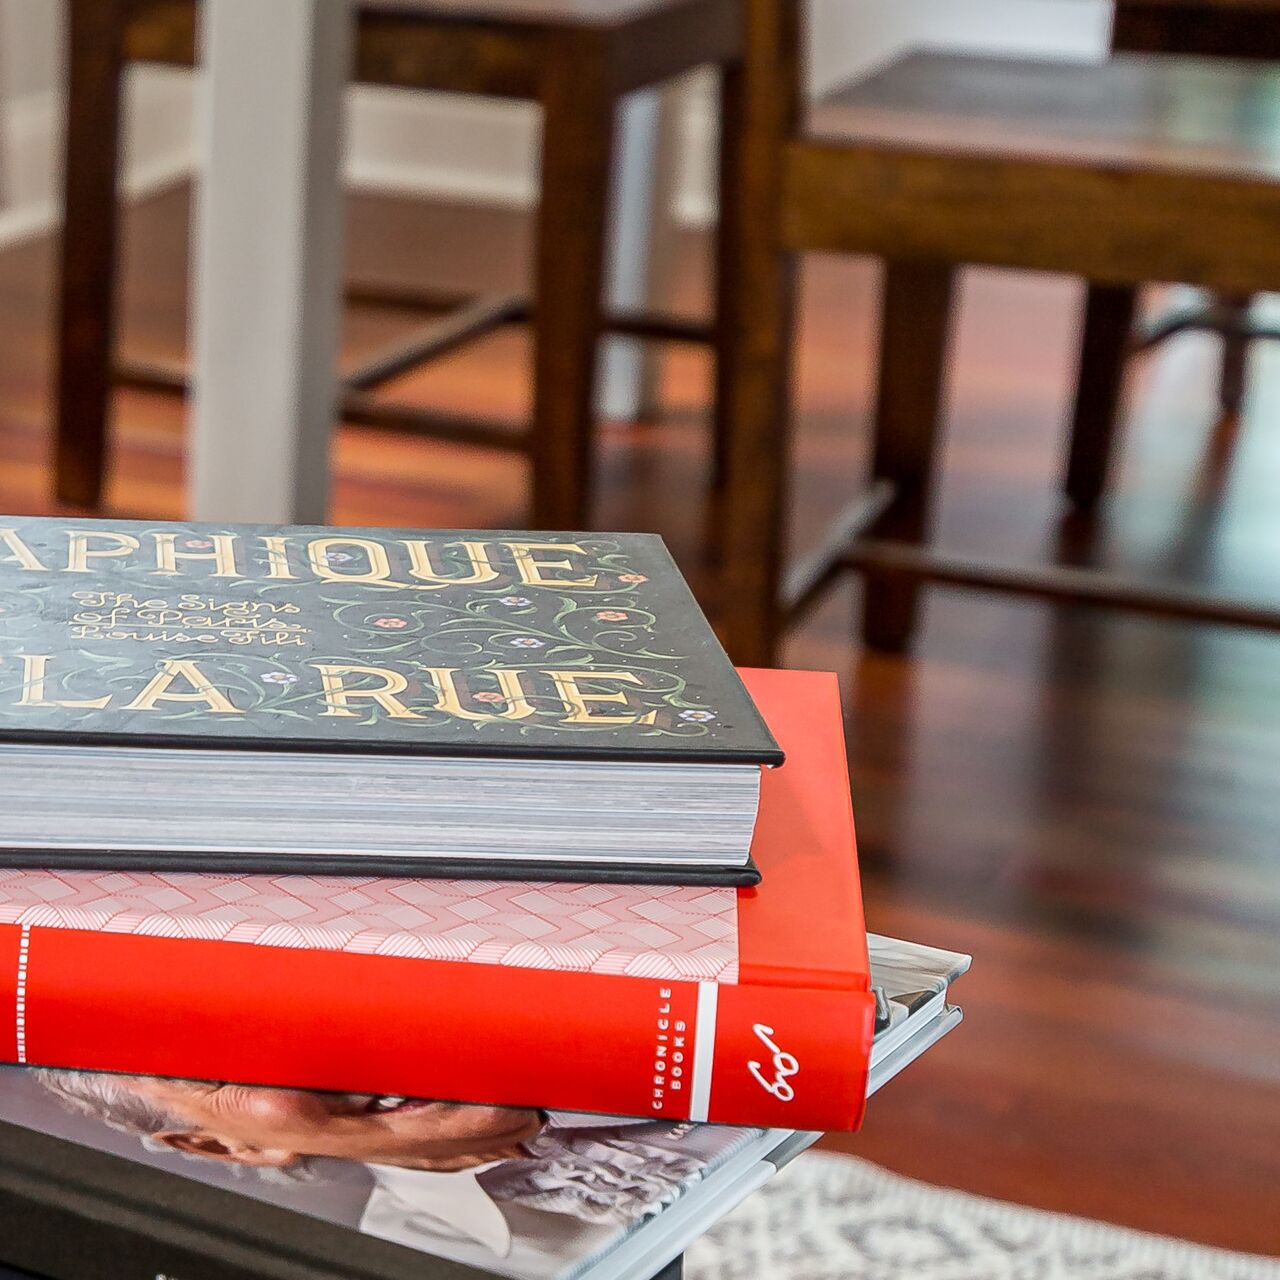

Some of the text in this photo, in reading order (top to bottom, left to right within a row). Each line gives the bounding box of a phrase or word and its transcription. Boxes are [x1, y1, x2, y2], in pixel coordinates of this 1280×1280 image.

[70, 626, 307, 646] Louise Fili
[71, 591, 301, 618] The Signs
[12, 653, 248, 715] LA
[311, 664, 657, 725] RUE
[651, 986, 672, 1111] CHRONICLE
[670, 1020, 687, 1091] BOOKS
